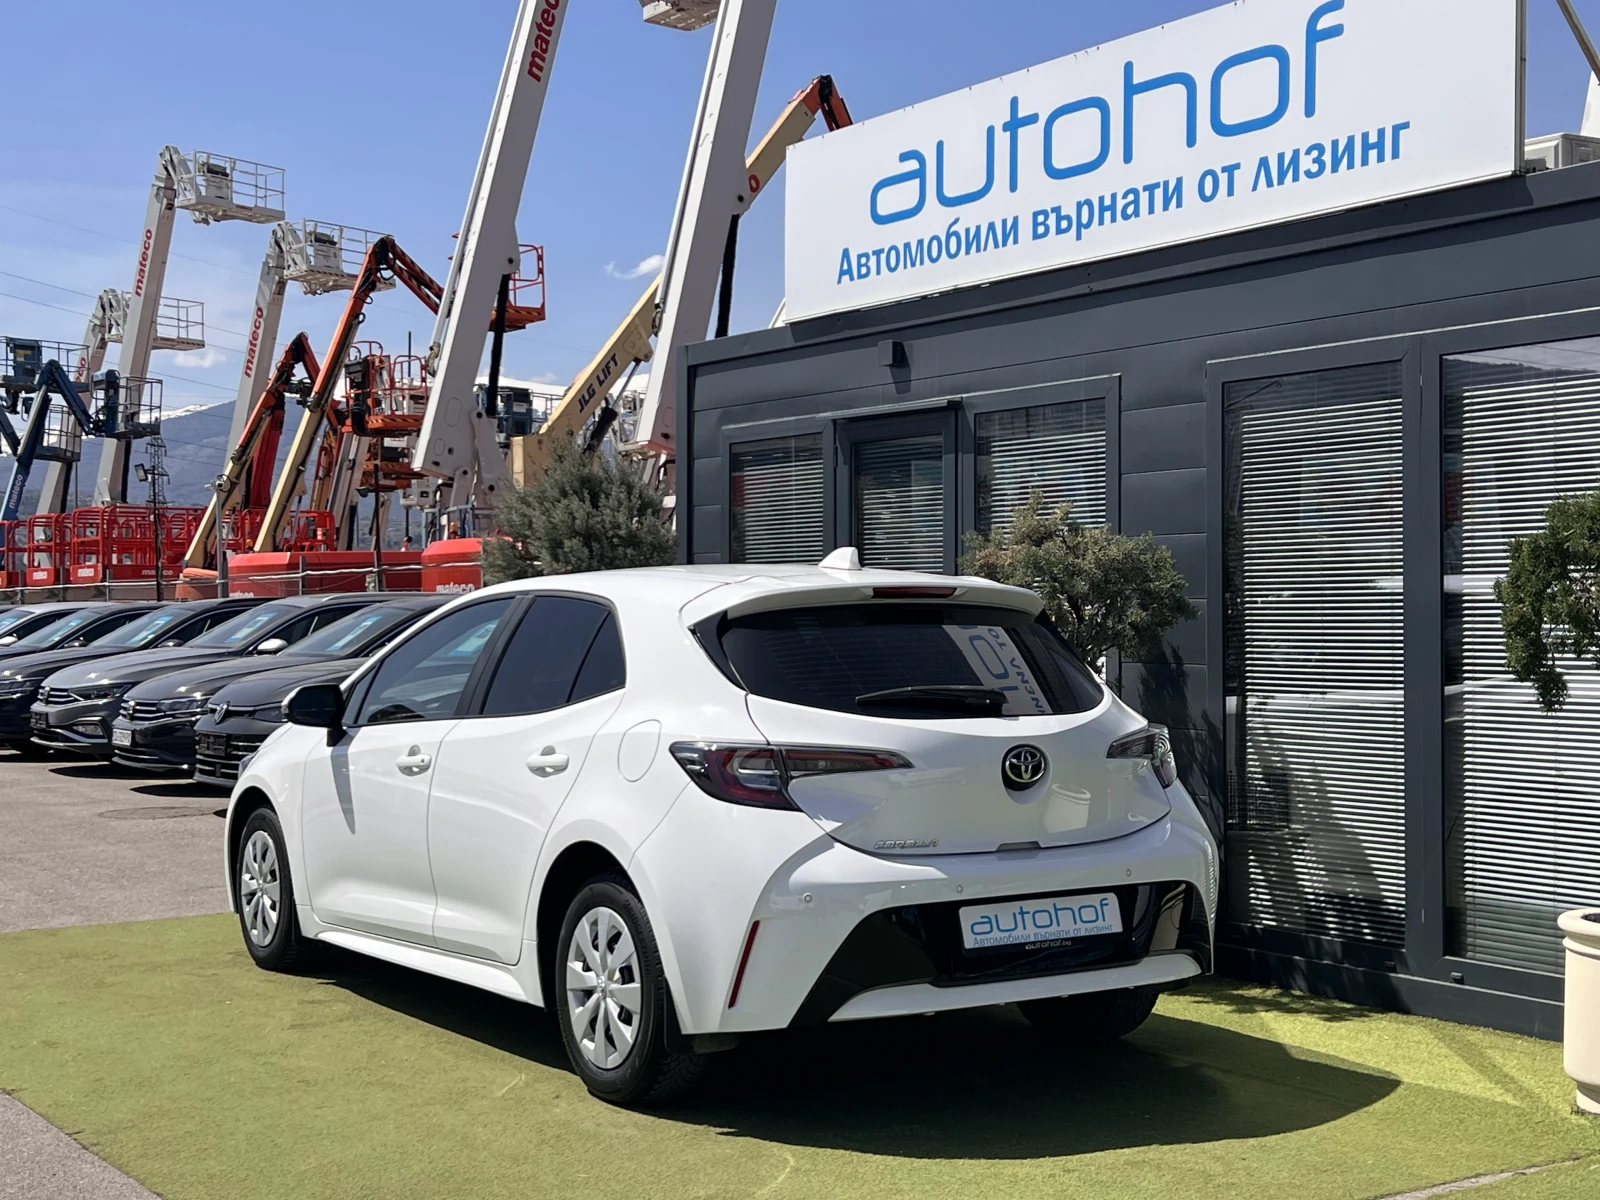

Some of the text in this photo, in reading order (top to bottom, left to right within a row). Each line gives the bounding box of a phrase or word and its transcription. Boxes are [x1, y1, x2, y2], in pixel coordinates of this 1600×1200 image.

[869, 0, 1345, 226] autohof
[836, 120, 1411, 285] Автомобили върнати от лизинг
[134, 228, 153, 298] mateco
[244, 306, 264, 379] mateco
[577, 352, 619, 414] JLG LIFT
[141, 568, 174, 577] maco
[969, 897, 1110, 936] autohof
[973, 924, 1114, 948] Автомобили върнати от лизинг
